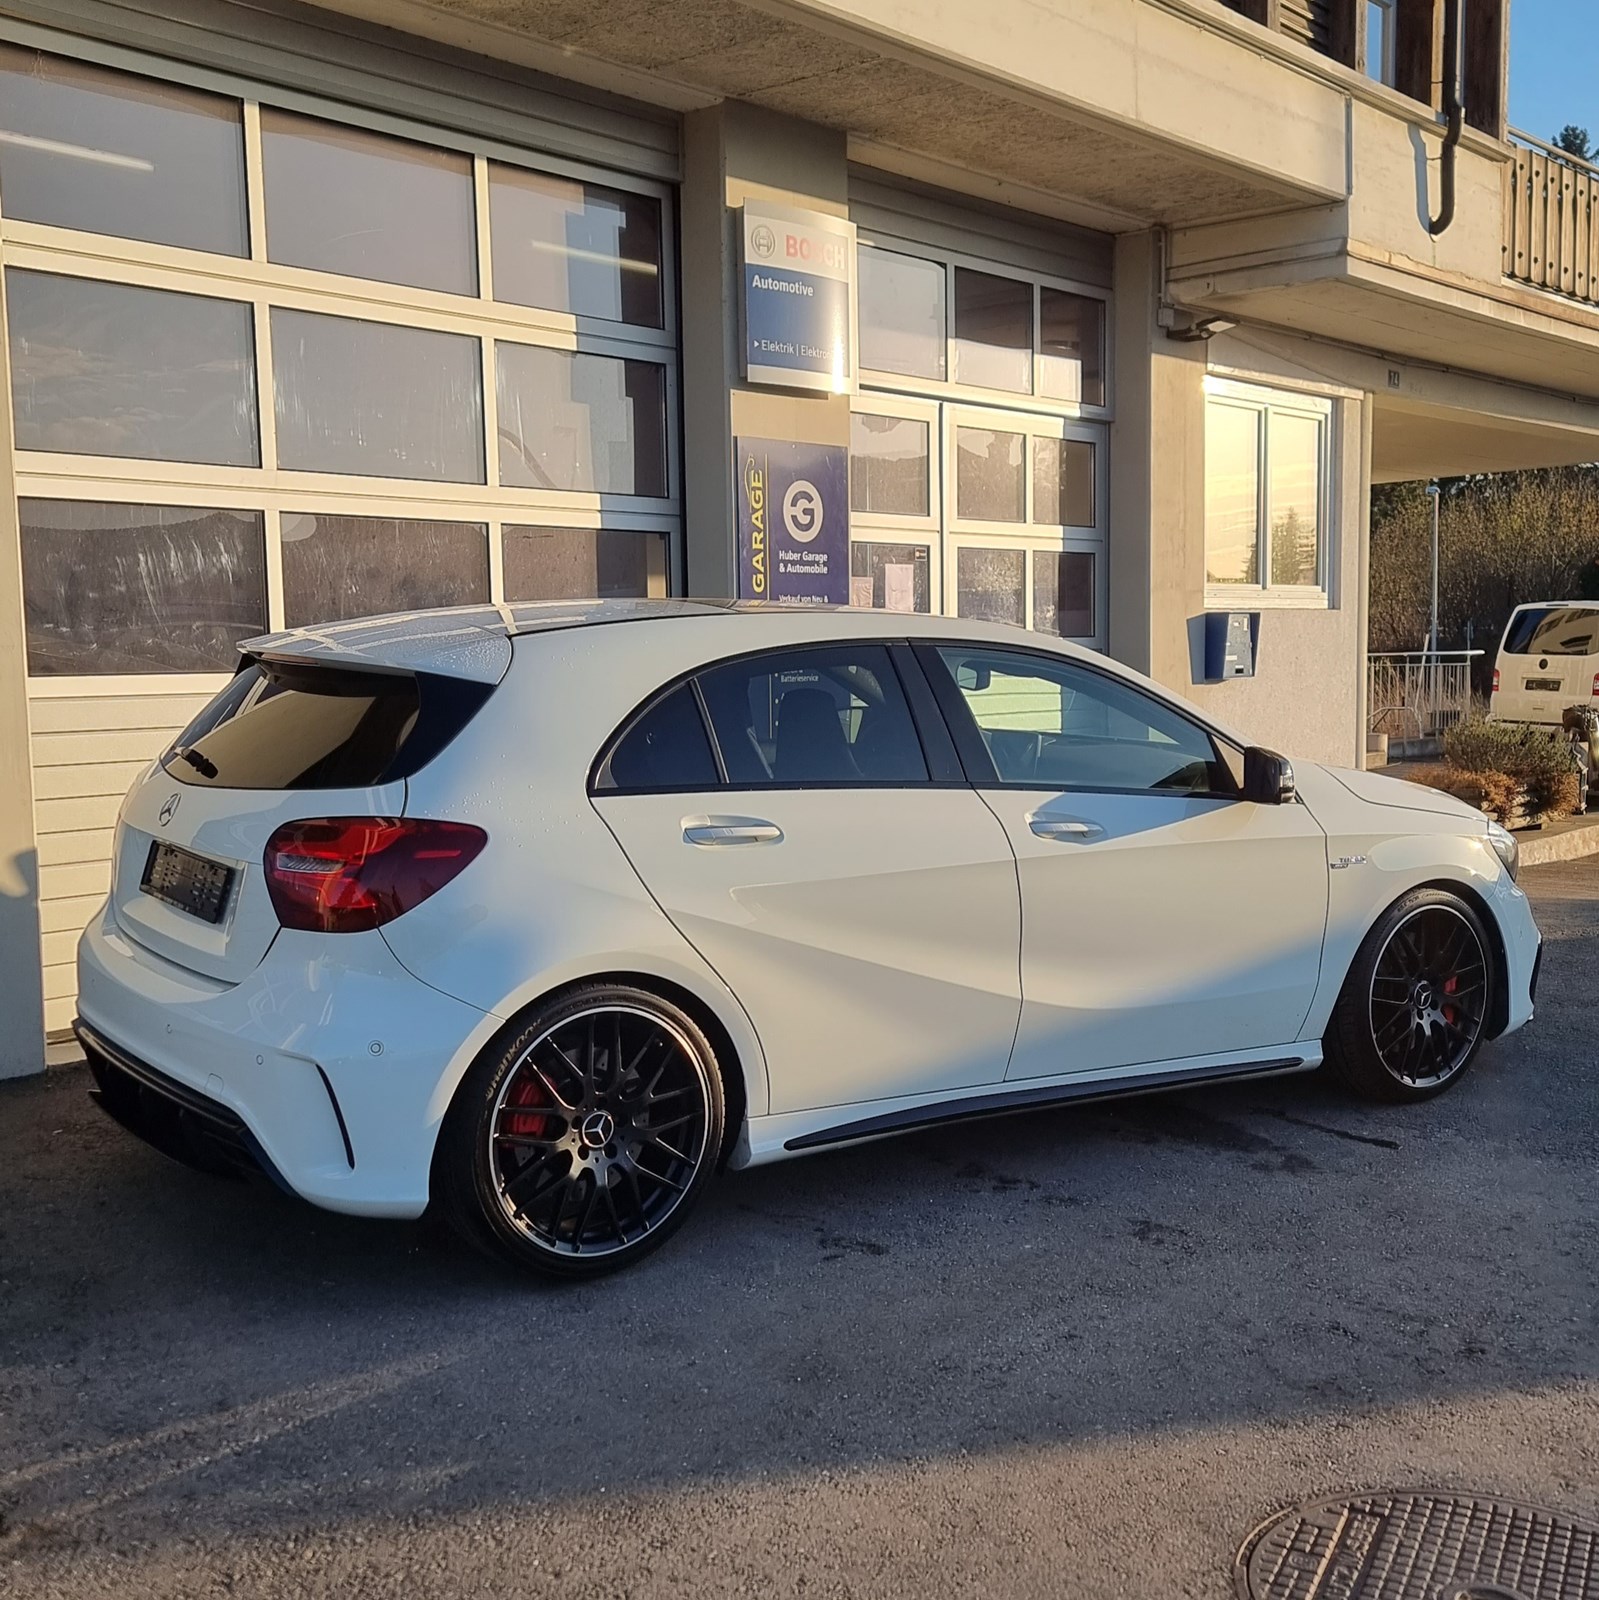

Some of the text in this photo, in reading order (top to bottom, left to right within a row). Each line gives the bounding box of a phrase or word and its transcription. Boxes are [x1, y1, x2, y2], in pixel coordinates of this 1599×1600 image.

[752, 274, 814, 297] Automotive
[761, 339, 794, 355] Elektrik
[800, 344, 845, 362] Elektron
[751, 468, 766, 594] GARAGE
[779, 550, 828, 564] Huber Garage
[779, 562, 828, 575] & Automobile
[780, 673, 819, 683] Batterieservice
